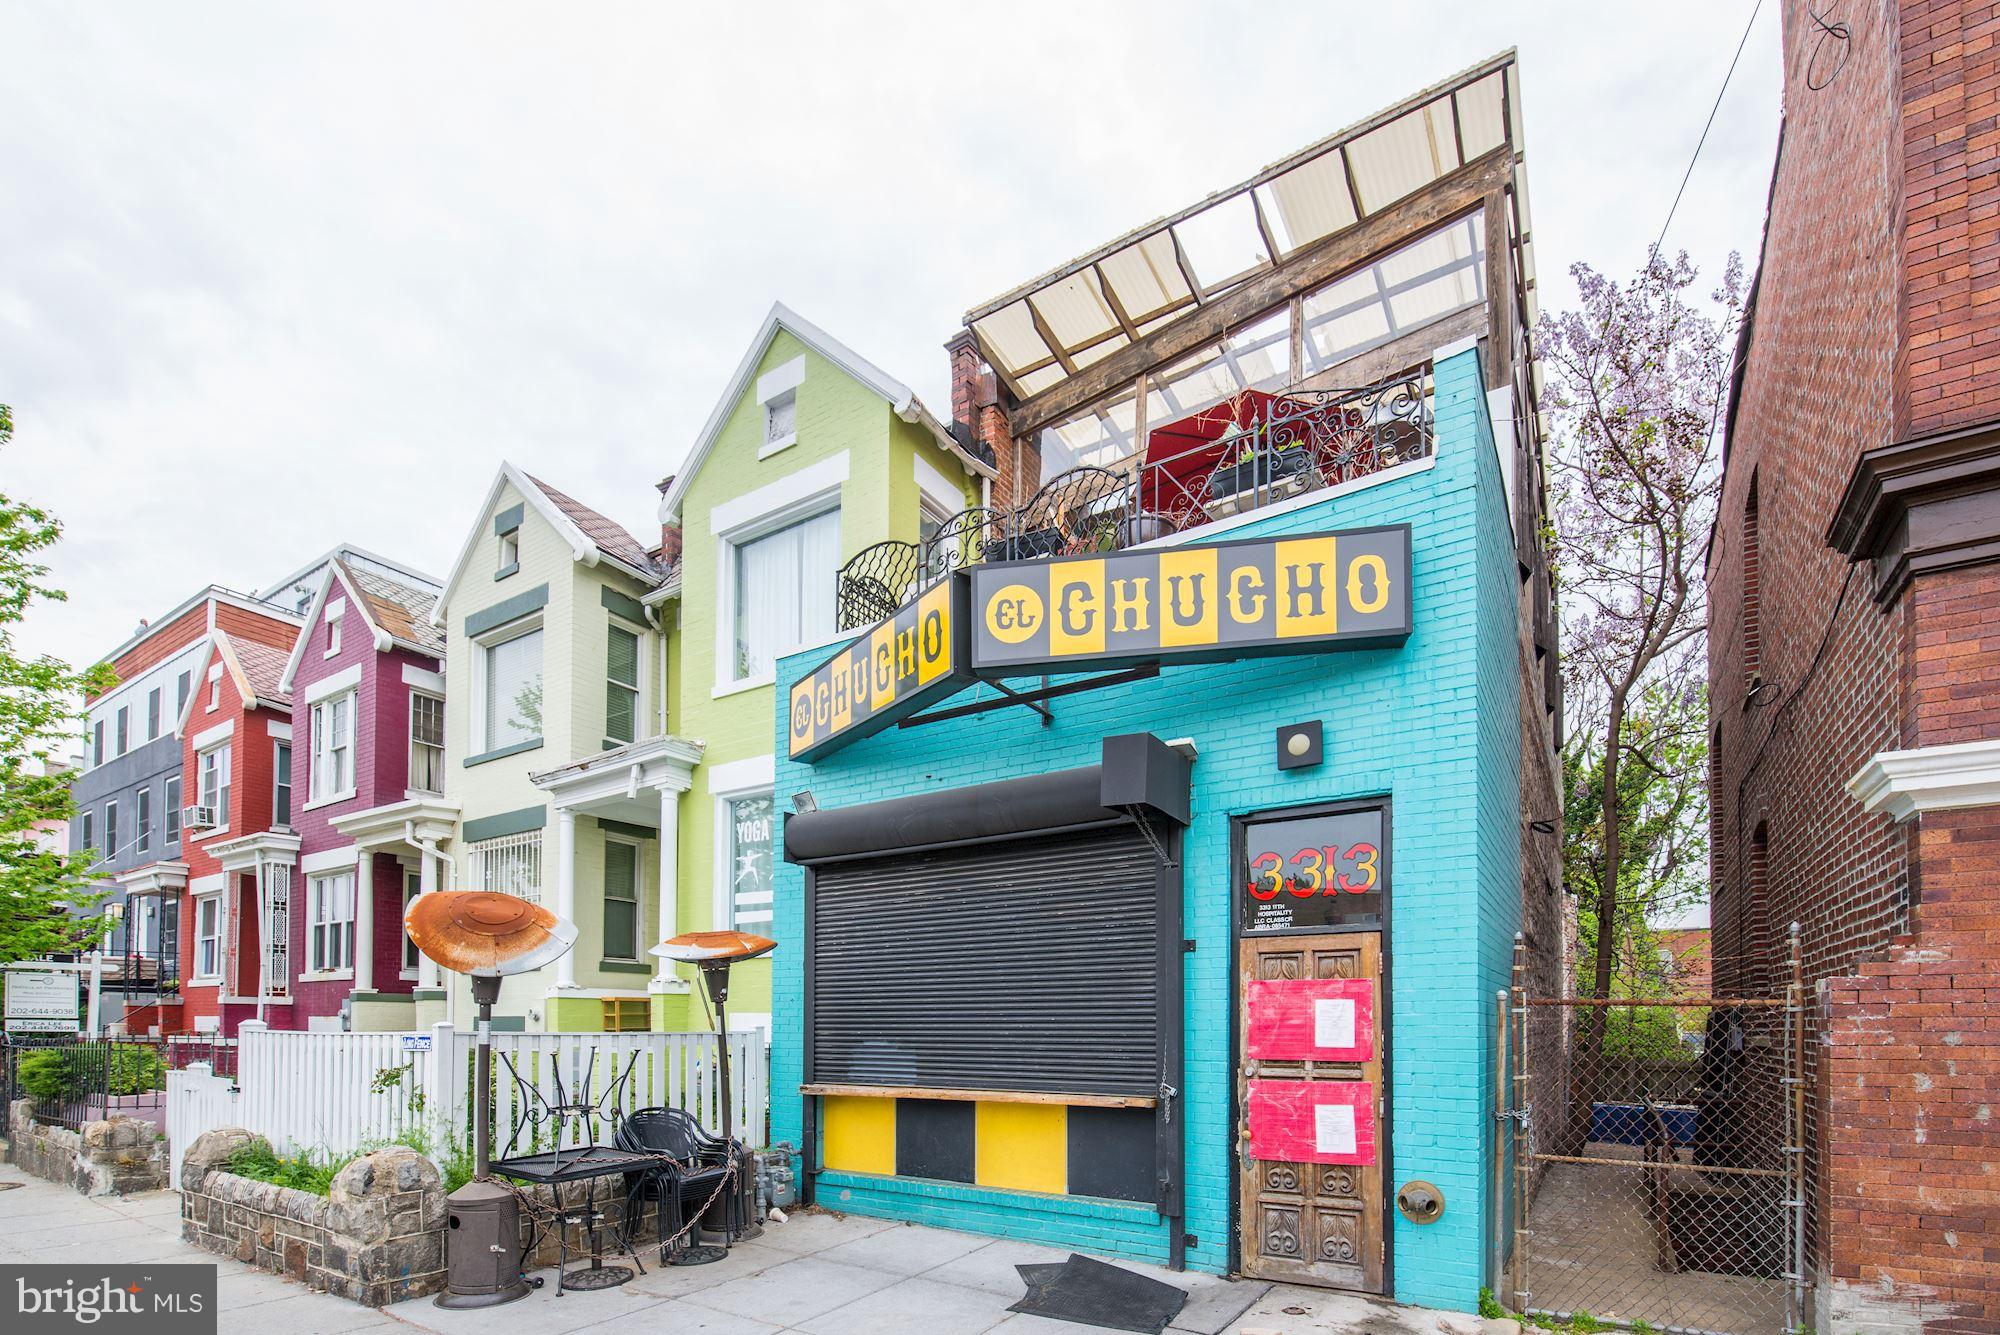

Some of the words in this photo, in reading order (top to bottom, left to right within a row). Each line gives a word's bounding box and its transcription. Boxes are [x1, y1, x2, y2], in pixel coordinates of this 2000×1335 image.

[995, 598, 1036, 629] EL
[1056, 554, 1391, 636] CHUCHO
[795, 703, 809, 730] EL
[816, 609, 943, 727] CHUCHO
[736, 819, 770, 844] YOGA
[1247, 842, 1379, 901] 3313
[1257, 909, 1293, 917] HOSPITALITY
